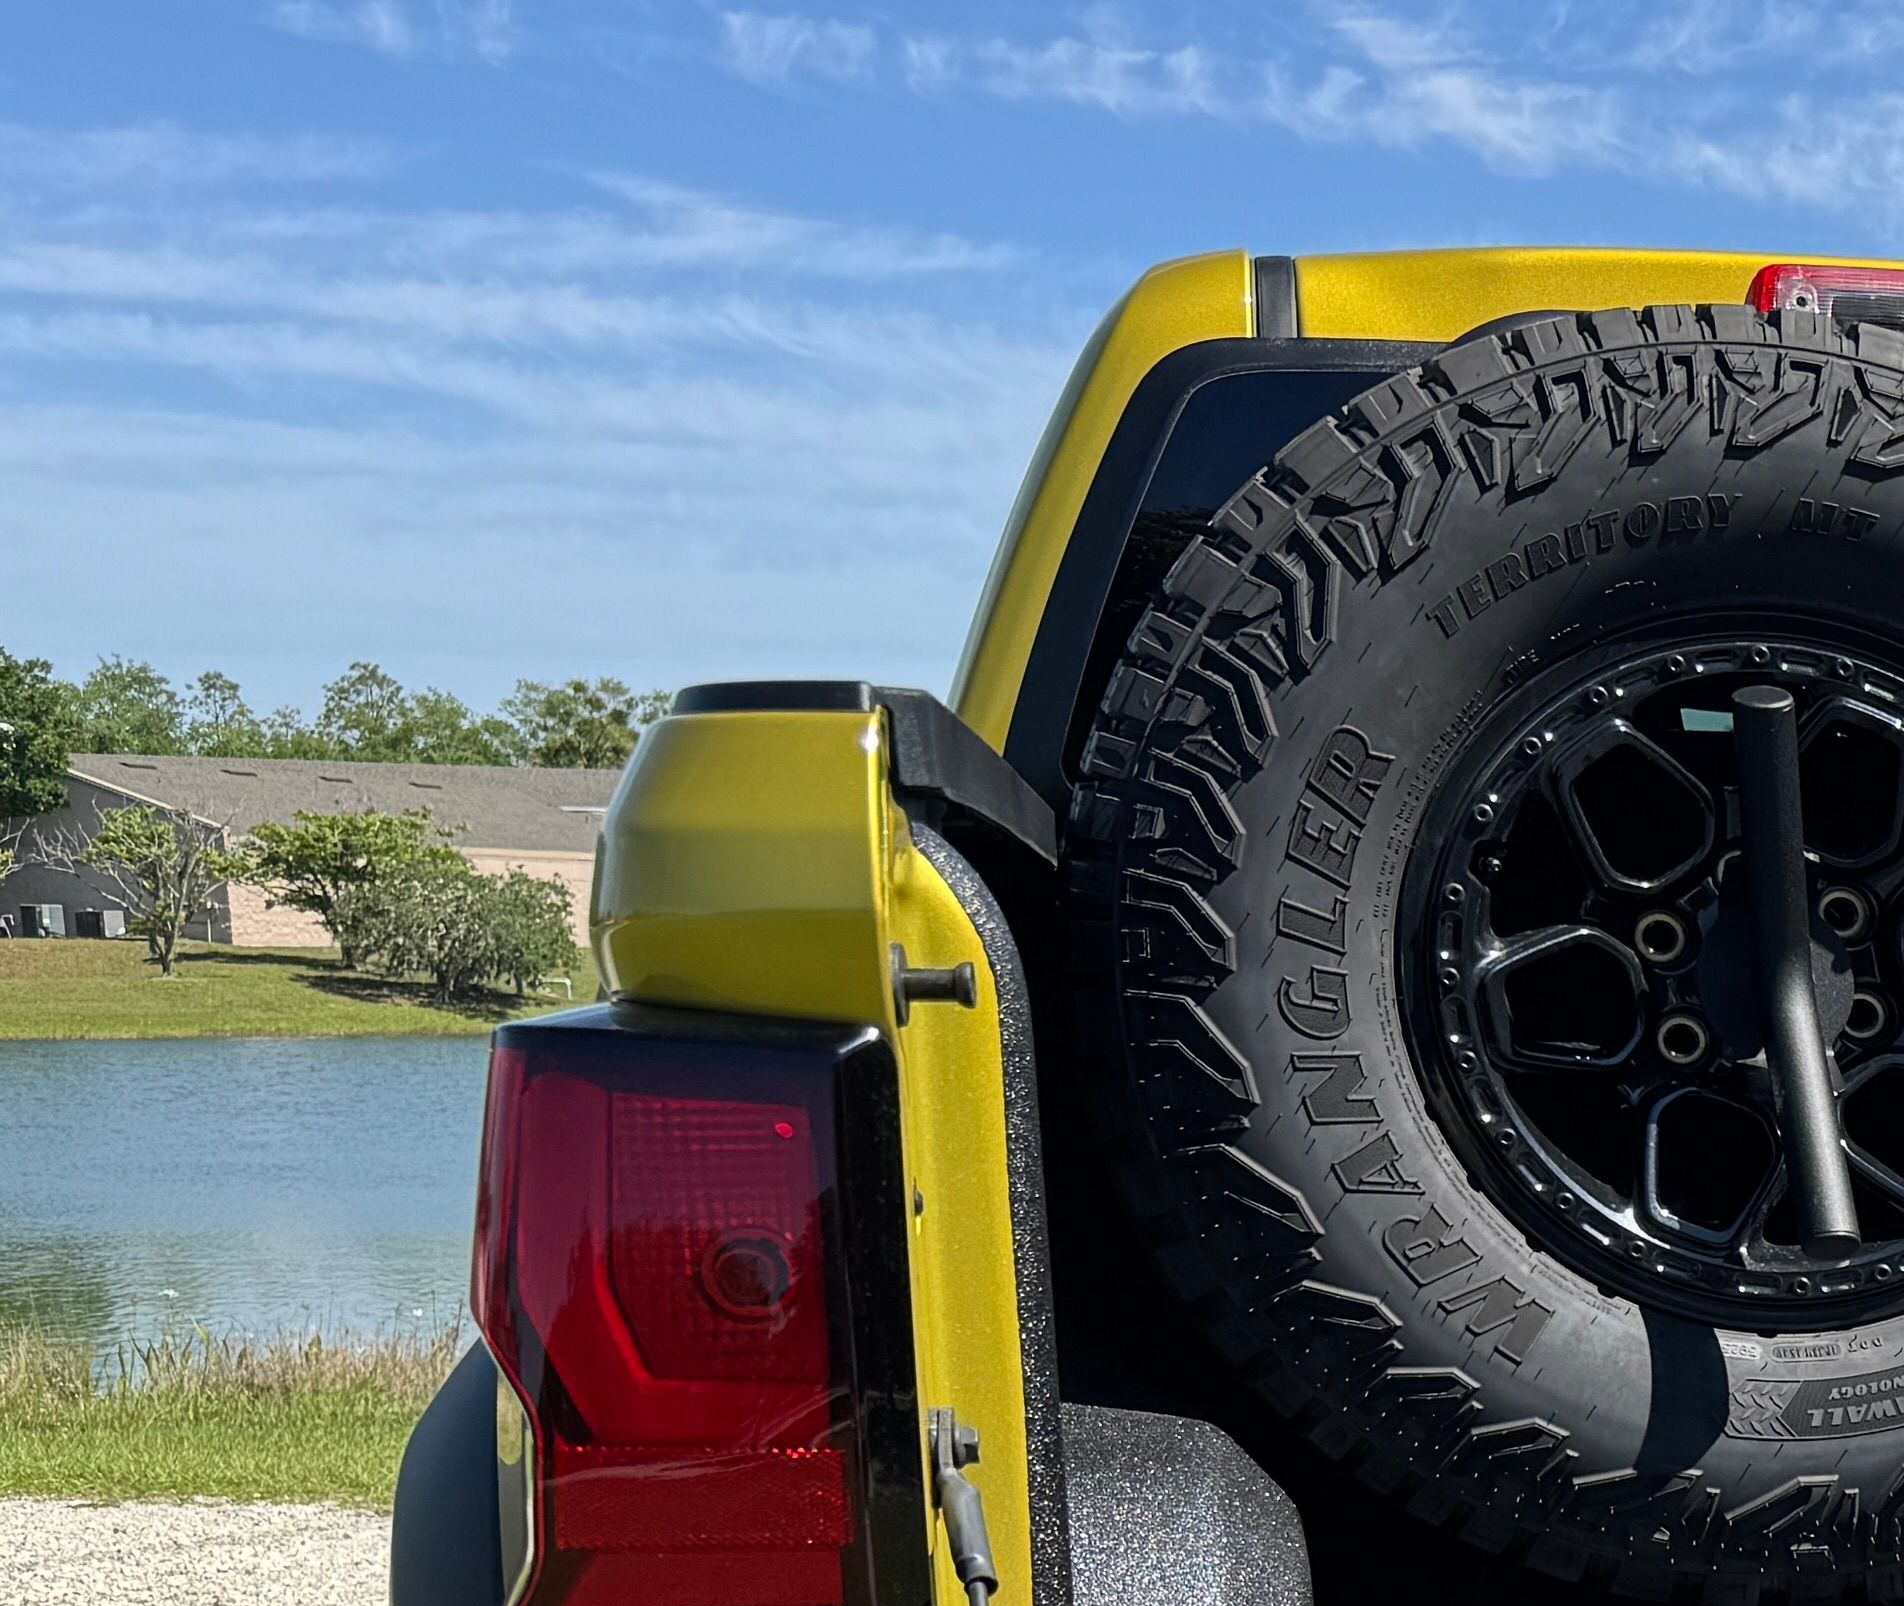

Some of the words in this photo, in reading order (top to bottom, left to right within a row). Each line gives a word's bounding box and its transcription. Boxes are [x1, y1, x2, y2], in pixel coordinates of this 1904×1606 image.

[1425, 493, 1742, 639] TERRITORY
[1790, 498, 1880, 542] MT
[1277, 724, 1556, 1366] WRANGLER
